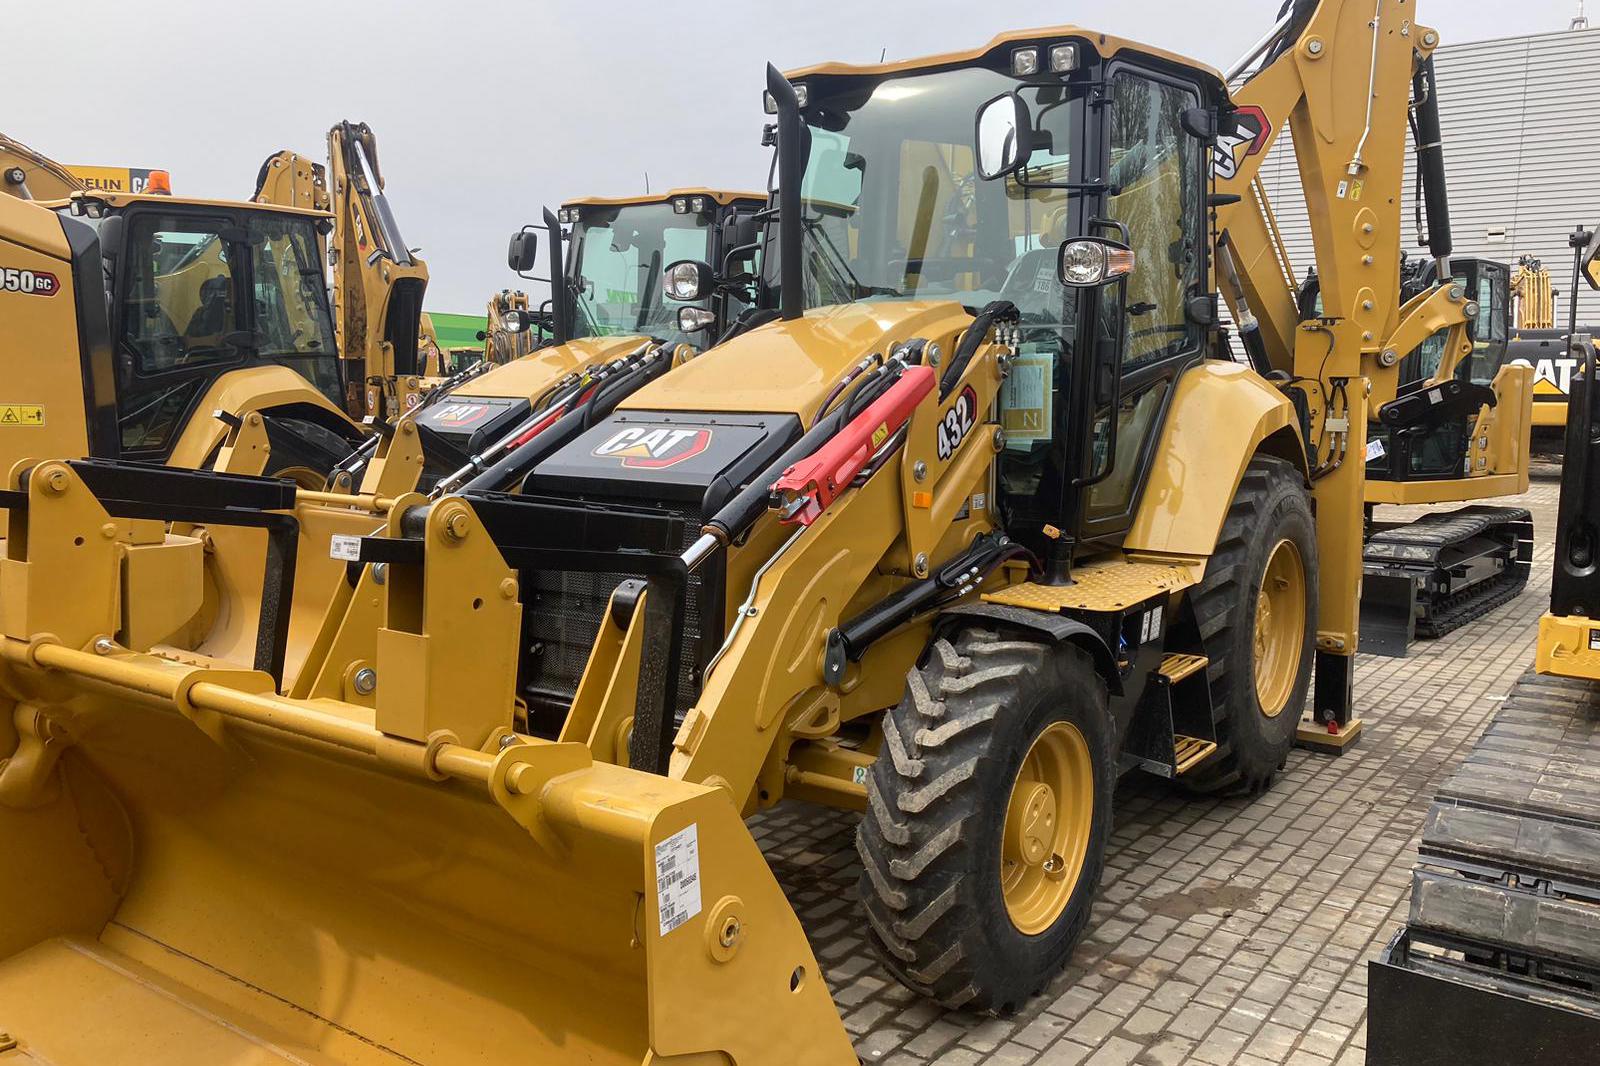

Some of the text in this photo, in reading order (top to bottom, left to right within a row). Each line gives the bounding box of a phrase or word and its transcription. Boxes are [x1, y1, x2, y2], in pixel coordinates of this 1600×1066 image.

[35, 277, 52, 290] GC
[1510, 358, 1577, 394] AT
[432, 405, 483, 420] CAT
[937, 395, 972, 459] 432
[595, 427, 698, 458] CAT
